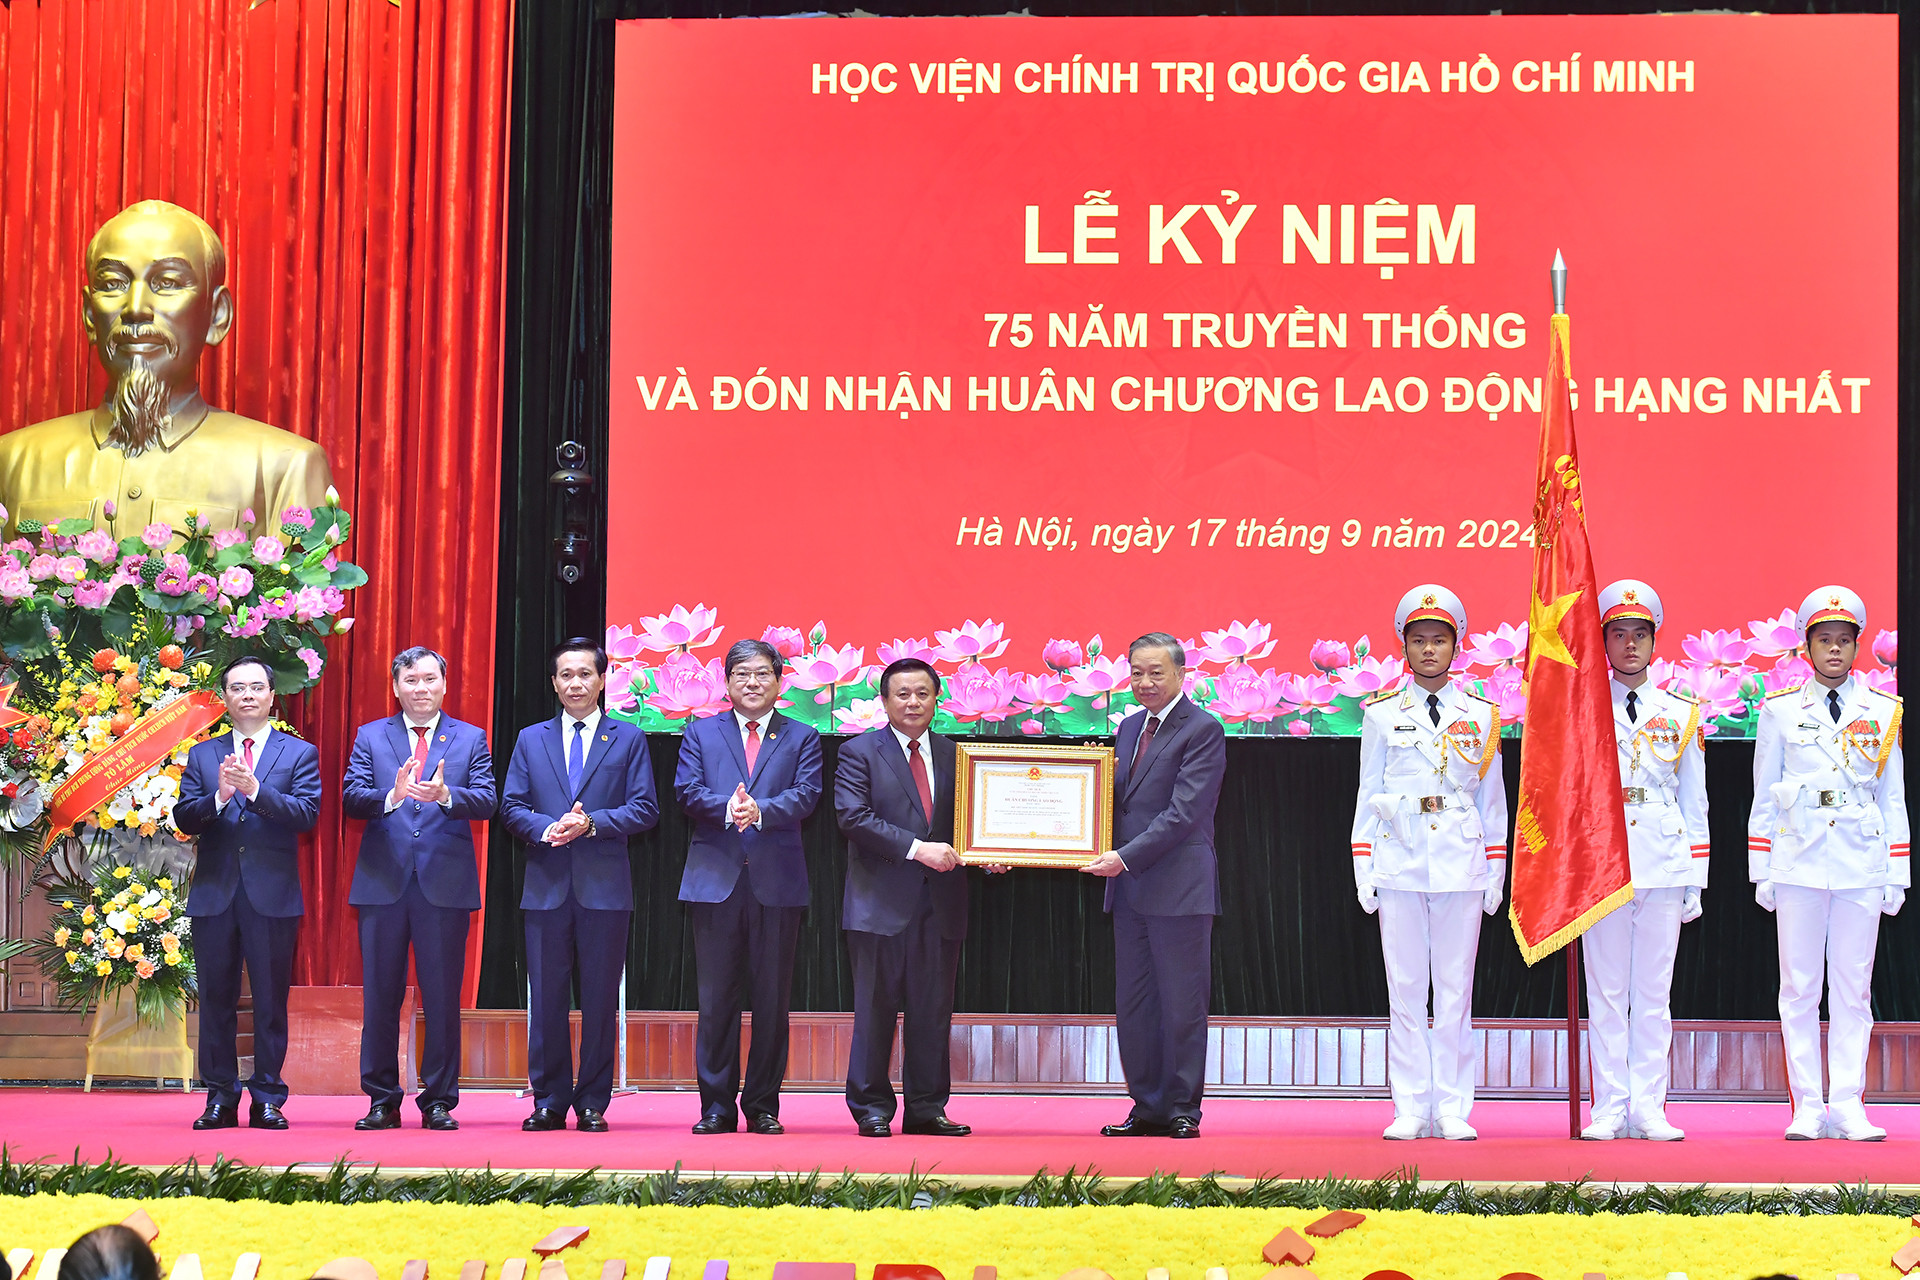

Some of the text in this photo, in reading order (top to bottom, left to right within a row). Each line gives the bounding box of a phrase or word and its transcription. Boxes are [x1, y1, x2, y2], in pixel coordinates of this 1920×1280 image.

[812, 52, 1695, 103] HỌC VIỆN CHÍNH TRỊ QUỐC GIA HỒ CHÍ MINH
[1025, 189, 1476, 280] LỄ KỶ NIỆM
[984, 304, 1526, 349] 75 NĂM TRUYỀN THỐNG
[635, 366, 1871, 422] VÀ ĐÓN NHẬN HUÂN CHƯƠNG LAO ĐỘN HẠNG NHẤT
[956, 516, 1536, 555] Hà Nội, ngày 17 tháng 9 năm 2024
[115, 755, 136, 772] LÂM
[1517, 805, 1548, 856] MINH
